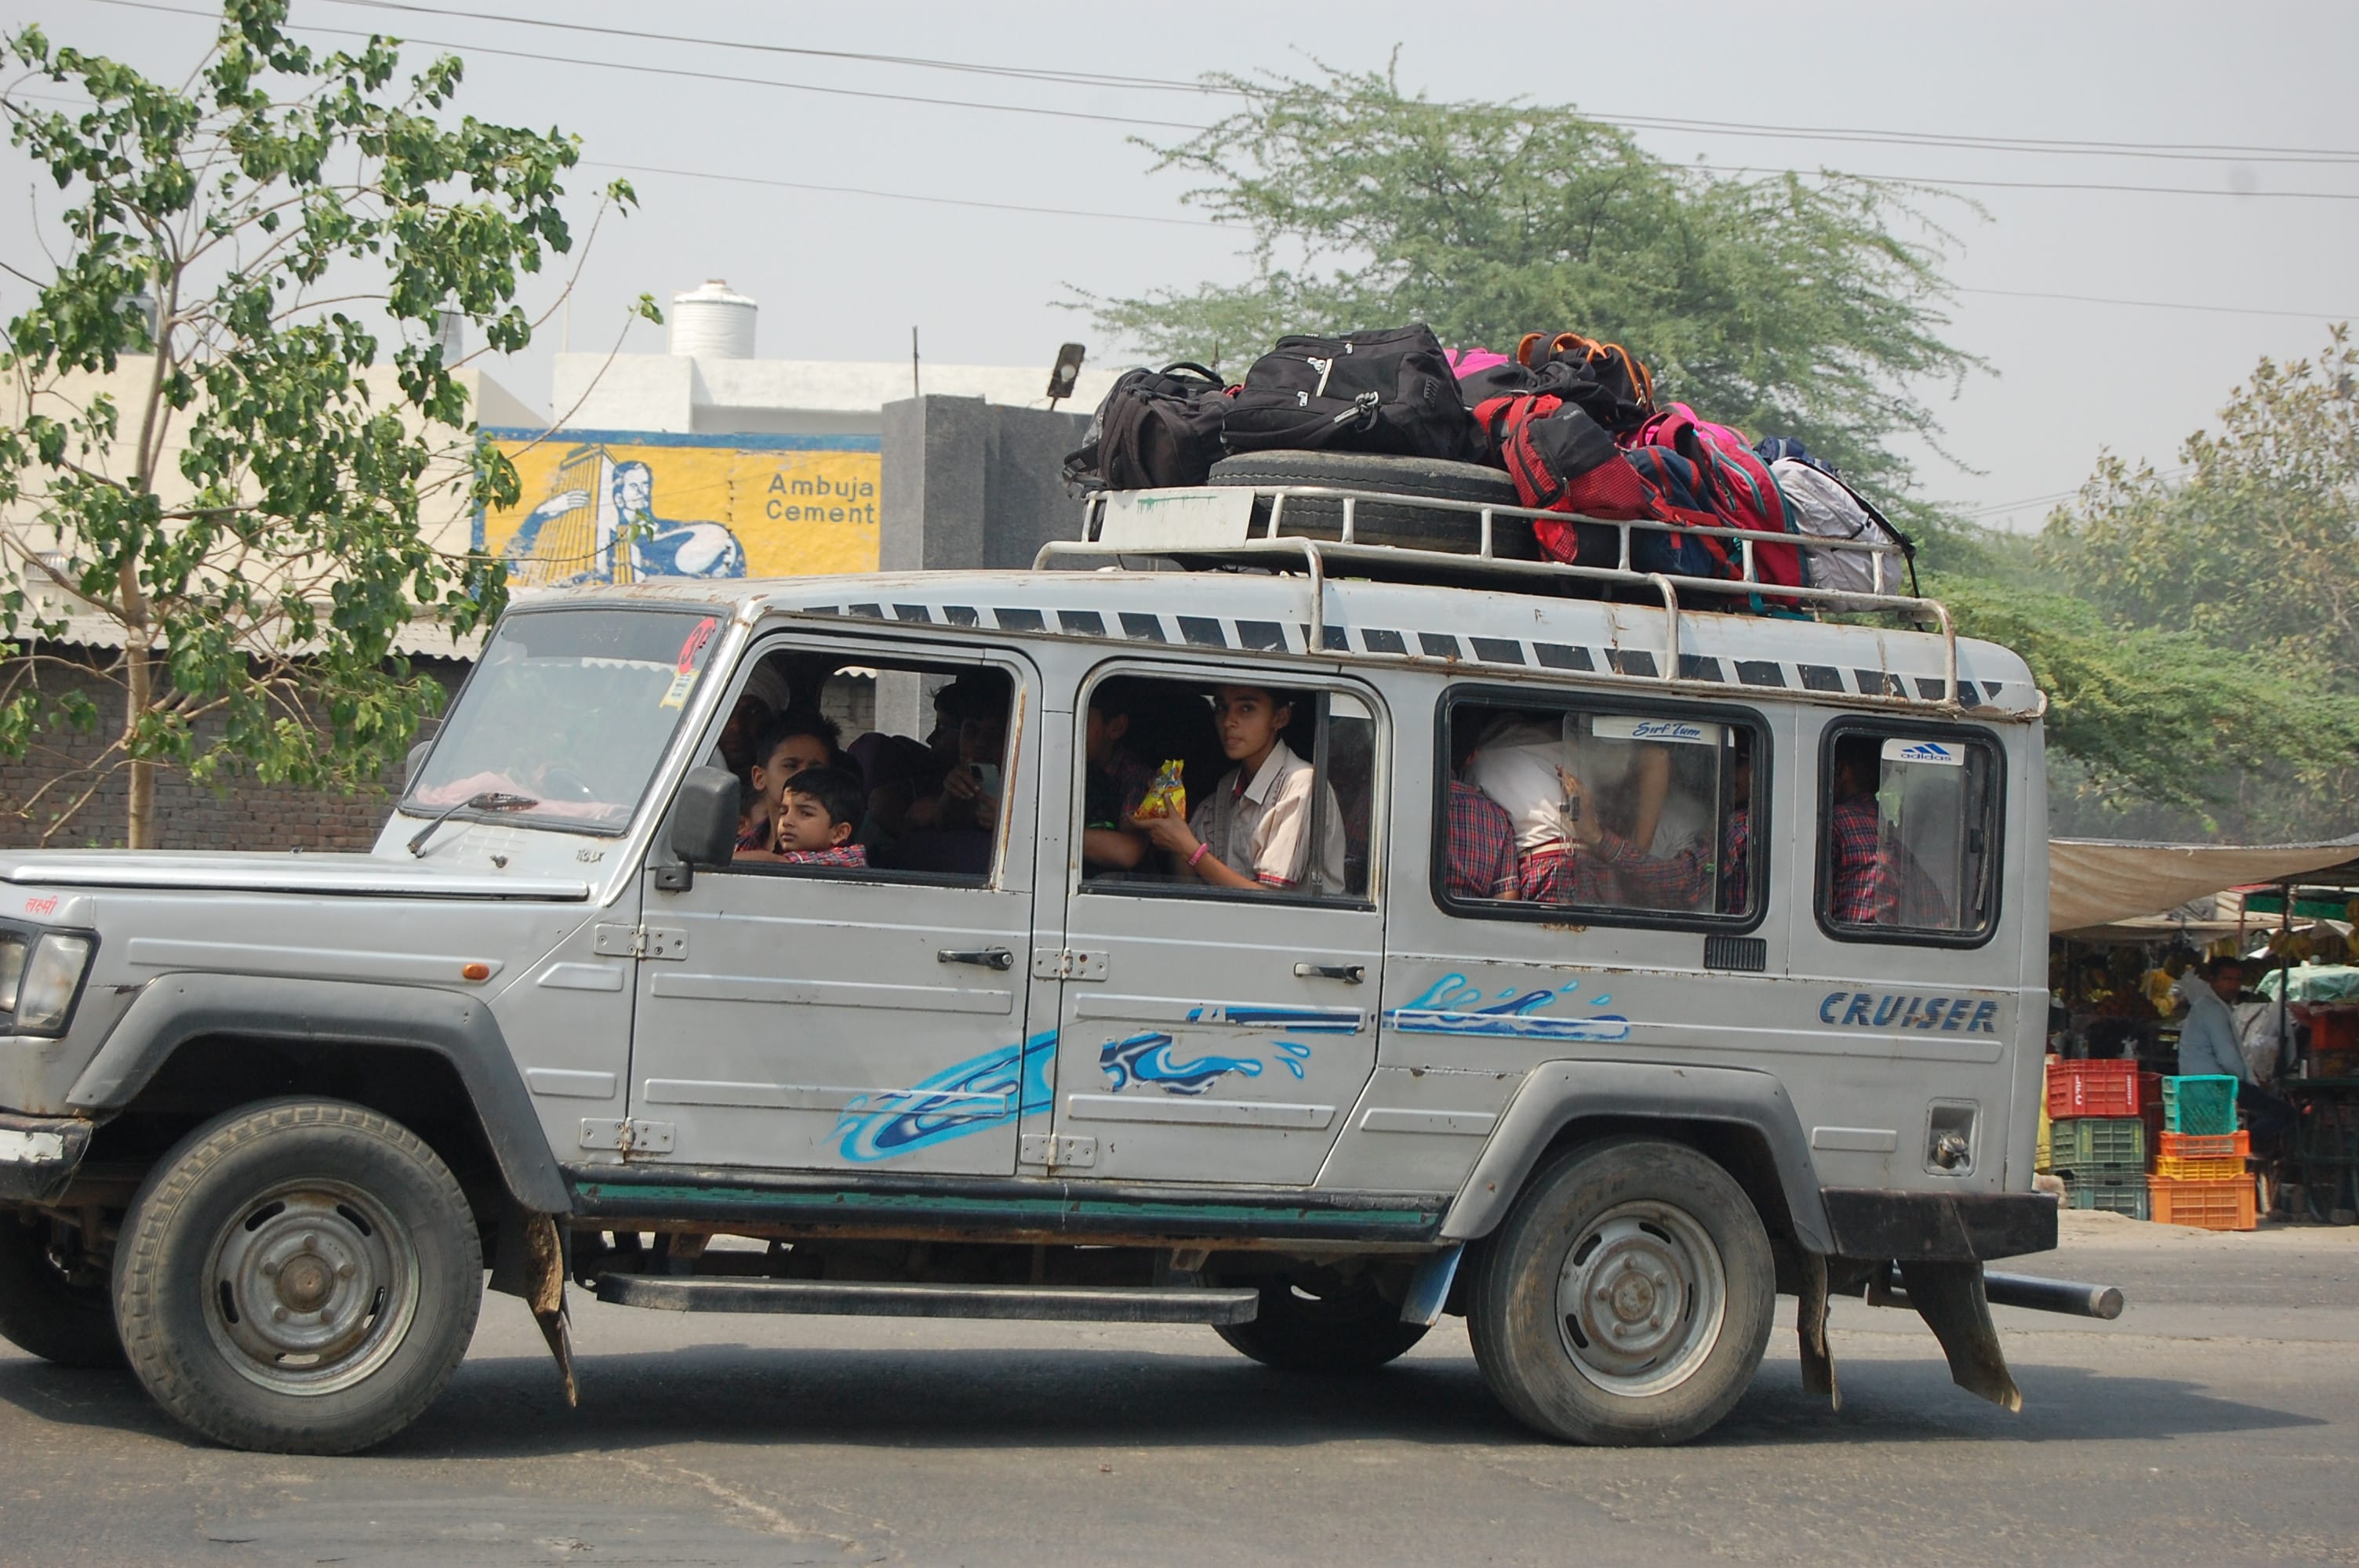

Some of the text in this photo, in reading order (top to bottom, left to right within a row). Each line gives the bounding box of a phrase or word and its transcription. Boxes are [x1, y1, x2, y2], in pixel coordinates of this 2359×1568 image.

[768, 473, 874, 502] Ambuja
[766, 499, 875, 524] Cement
[1632, 722, 1670, 736] Sirf
[1900, 752, 1952, 761] adidas
[1819, 992, 1998, 1033] CRUISER
